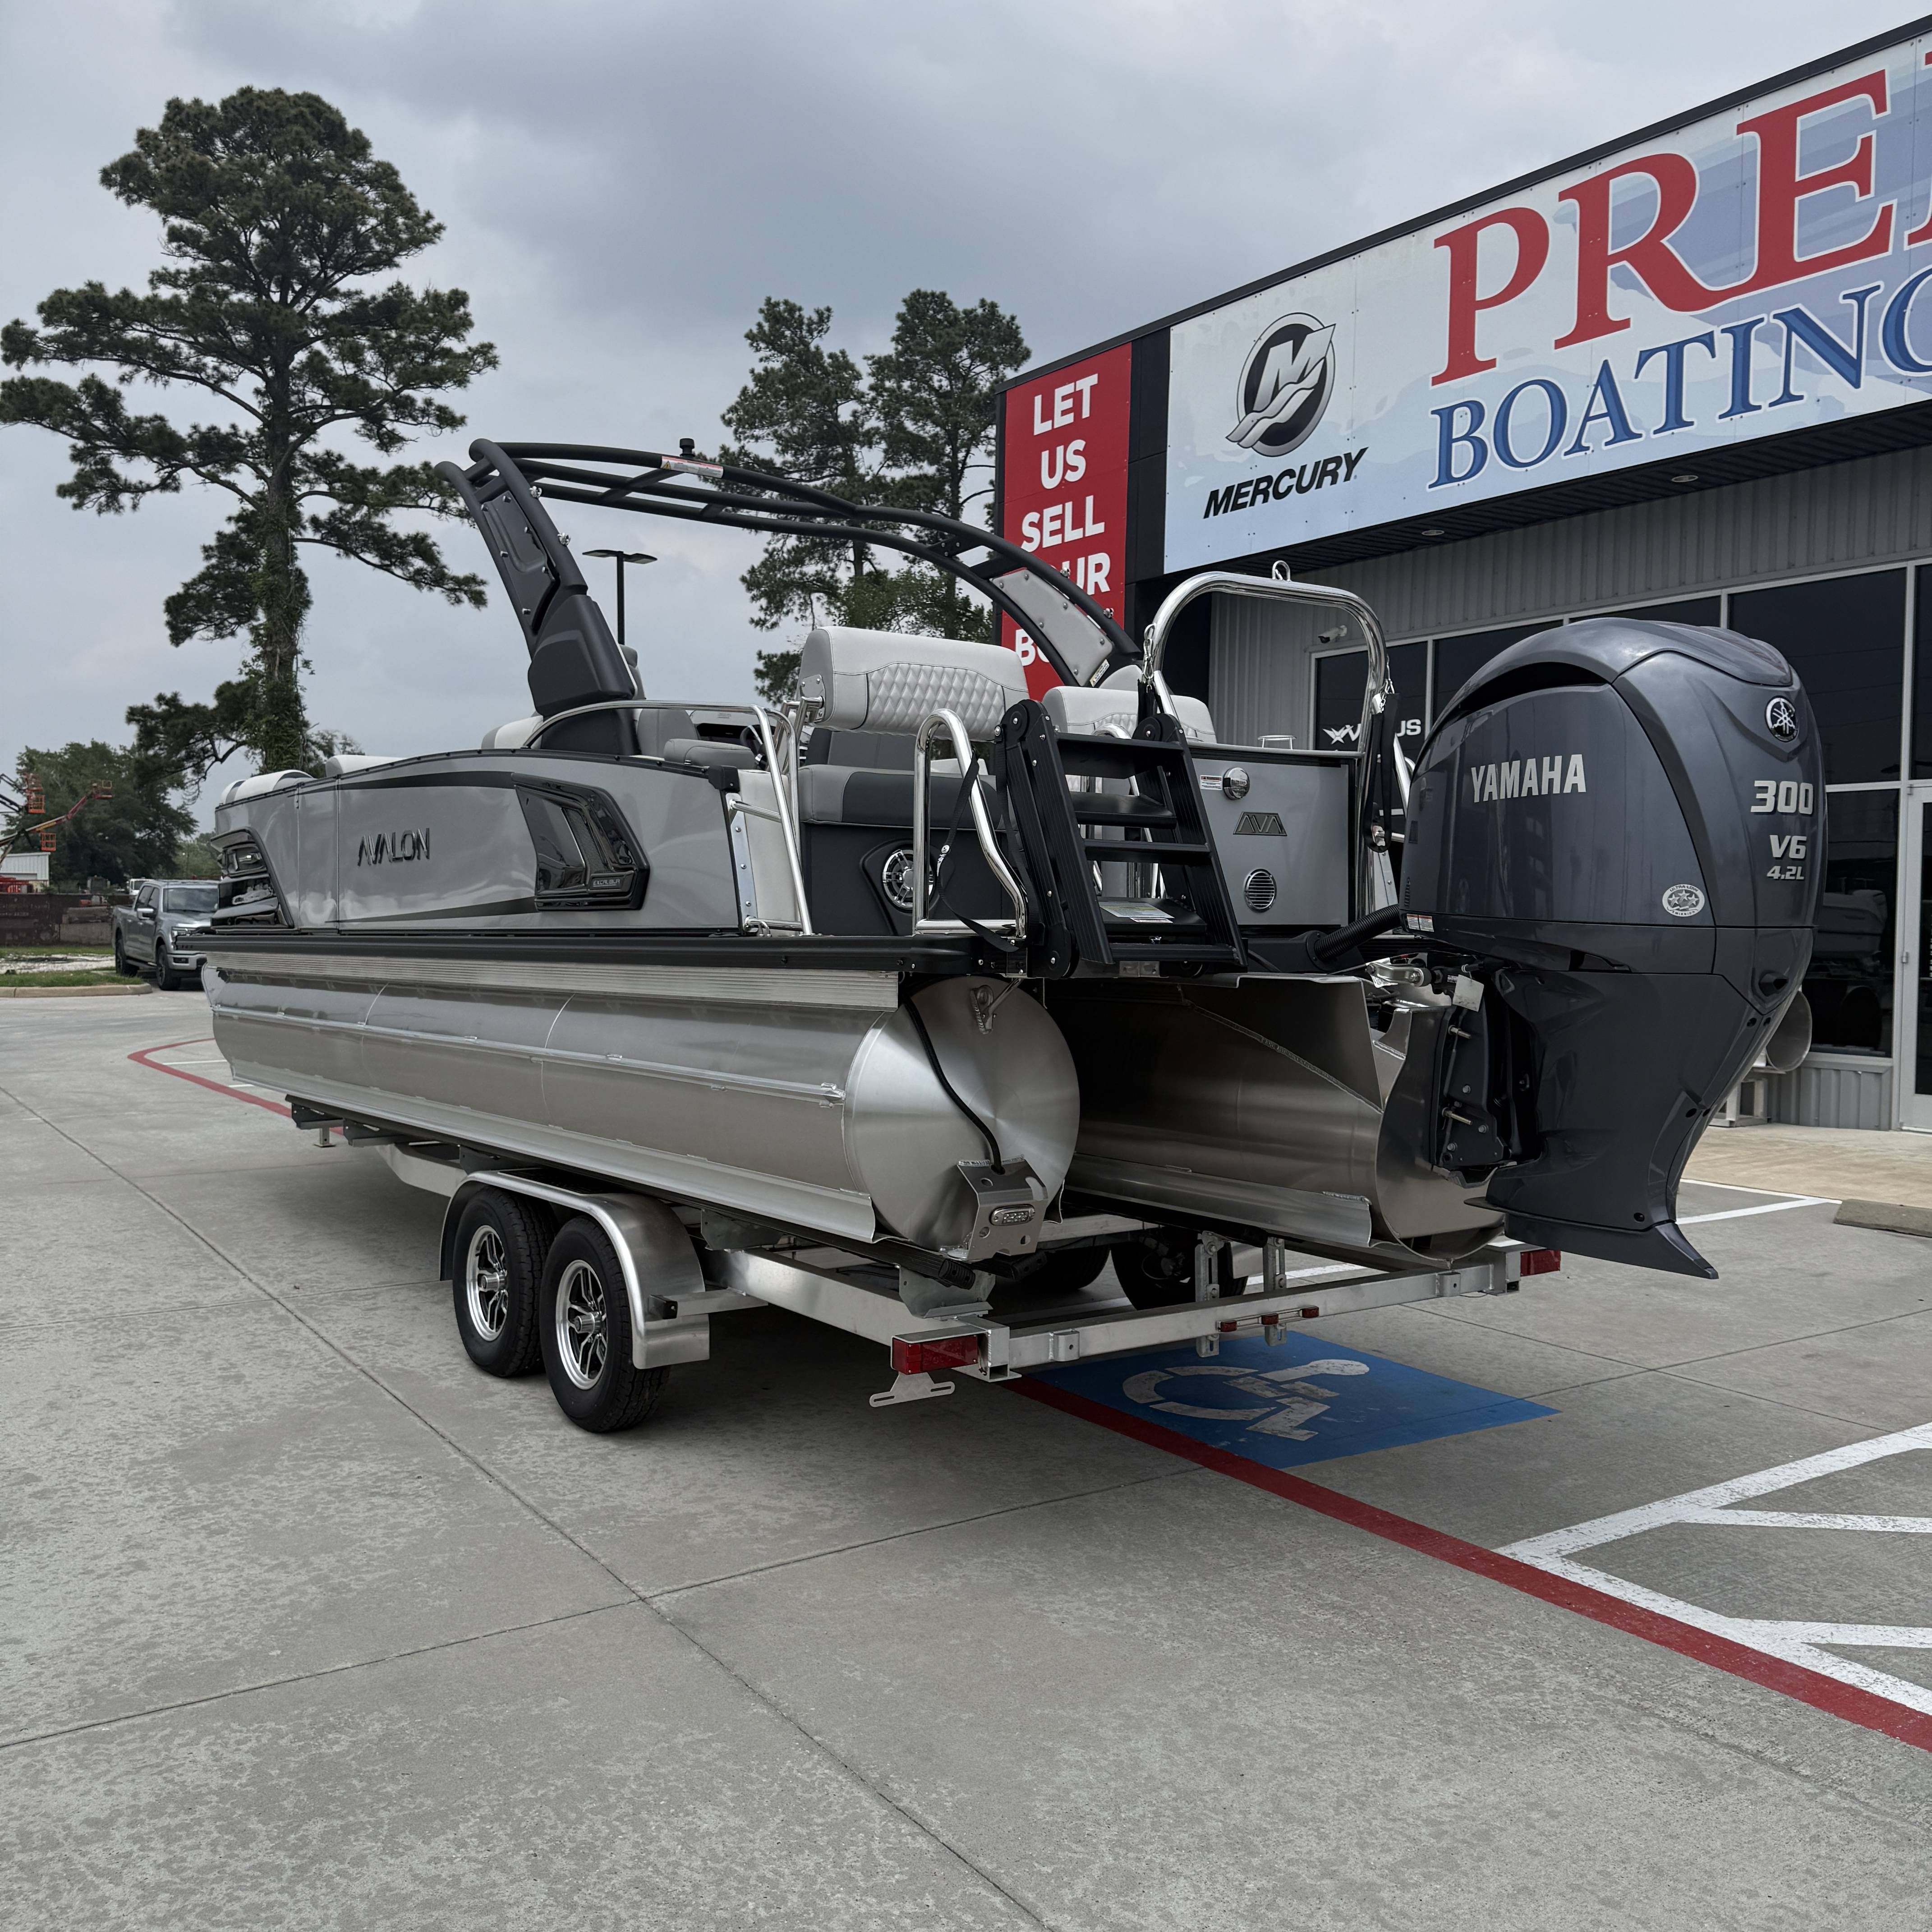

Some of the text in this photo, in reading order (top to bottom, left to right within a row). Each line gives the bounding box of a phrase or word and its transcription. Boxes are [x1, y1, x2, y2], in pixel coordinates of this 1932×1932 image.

[1431, 52, 1932, 387] PRE
[1034, 373, 1098, 436] LET
[1041, 439, 1086, 489] US
[1203, 446, 1369, 519] MERCURY
[1021, 495, 1105, 552] SELL
[1471, 754, 1586, 803] YAMAHA
[1751, 781, 1813, 814] 300
[357, 828, 430, 866] AVALON
[1770, 835, 1807, 859] V6
[1766, 866, 1804, 880] 4.2L
